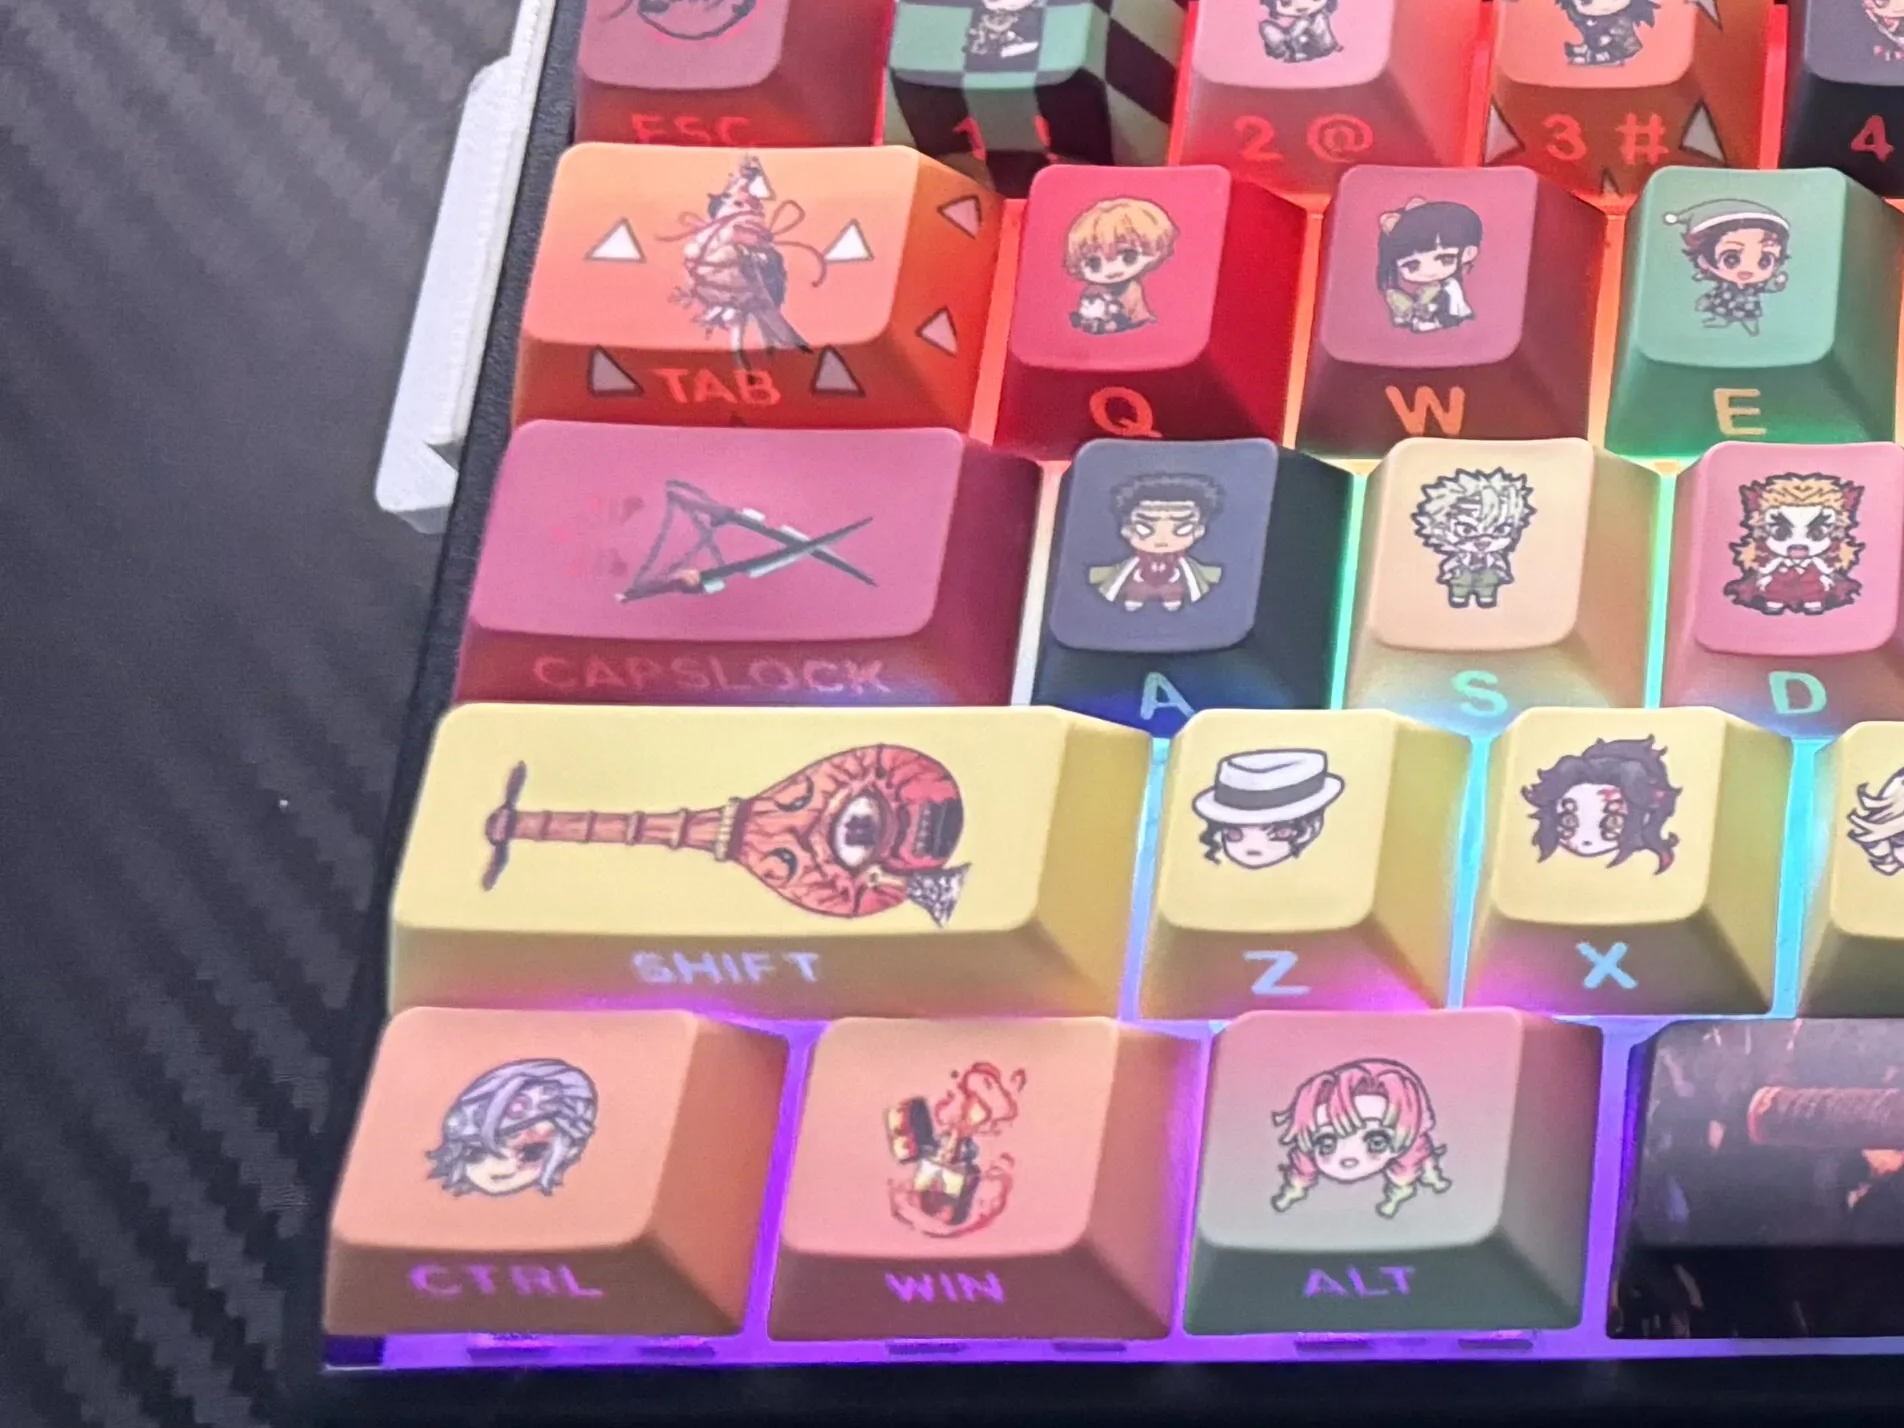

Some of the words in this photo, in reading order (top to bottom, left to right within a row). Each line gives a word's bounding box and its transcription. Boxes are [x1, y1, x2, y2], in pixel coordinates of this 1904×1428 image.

[632, 113, 753, 145] ESC
[1233, 115, 1284, 164] 2
[1306, 113, 1374, 164] @
[1542, 113, 1587, 161] 3
[1616, 113, 1671, 164] #
[1850, 115, 1895, 163] 4
[650, 367, 782, 408] TAB
[1089, 385, 1162, 438] Q
[1385, 385, 1466, 436] W
[1712, 387, 1767, 437] E
[533, 656, 892, 697] CAPSLOCK
[1141, 672, 1195, 720] A
[1451, 669, 1509, 718] S
[1769, 670, 1829, 716] D
[631, 950, 823, 984] SHIFT
[1243, 949, 1310, 997] Z
[1576, 941, 1638, 991] X
[409, 1263, 604, 1298] CTRL
[884, 1270, 1005, 1304] WIN
[1302, 1265, 1416, 1299] ALT
